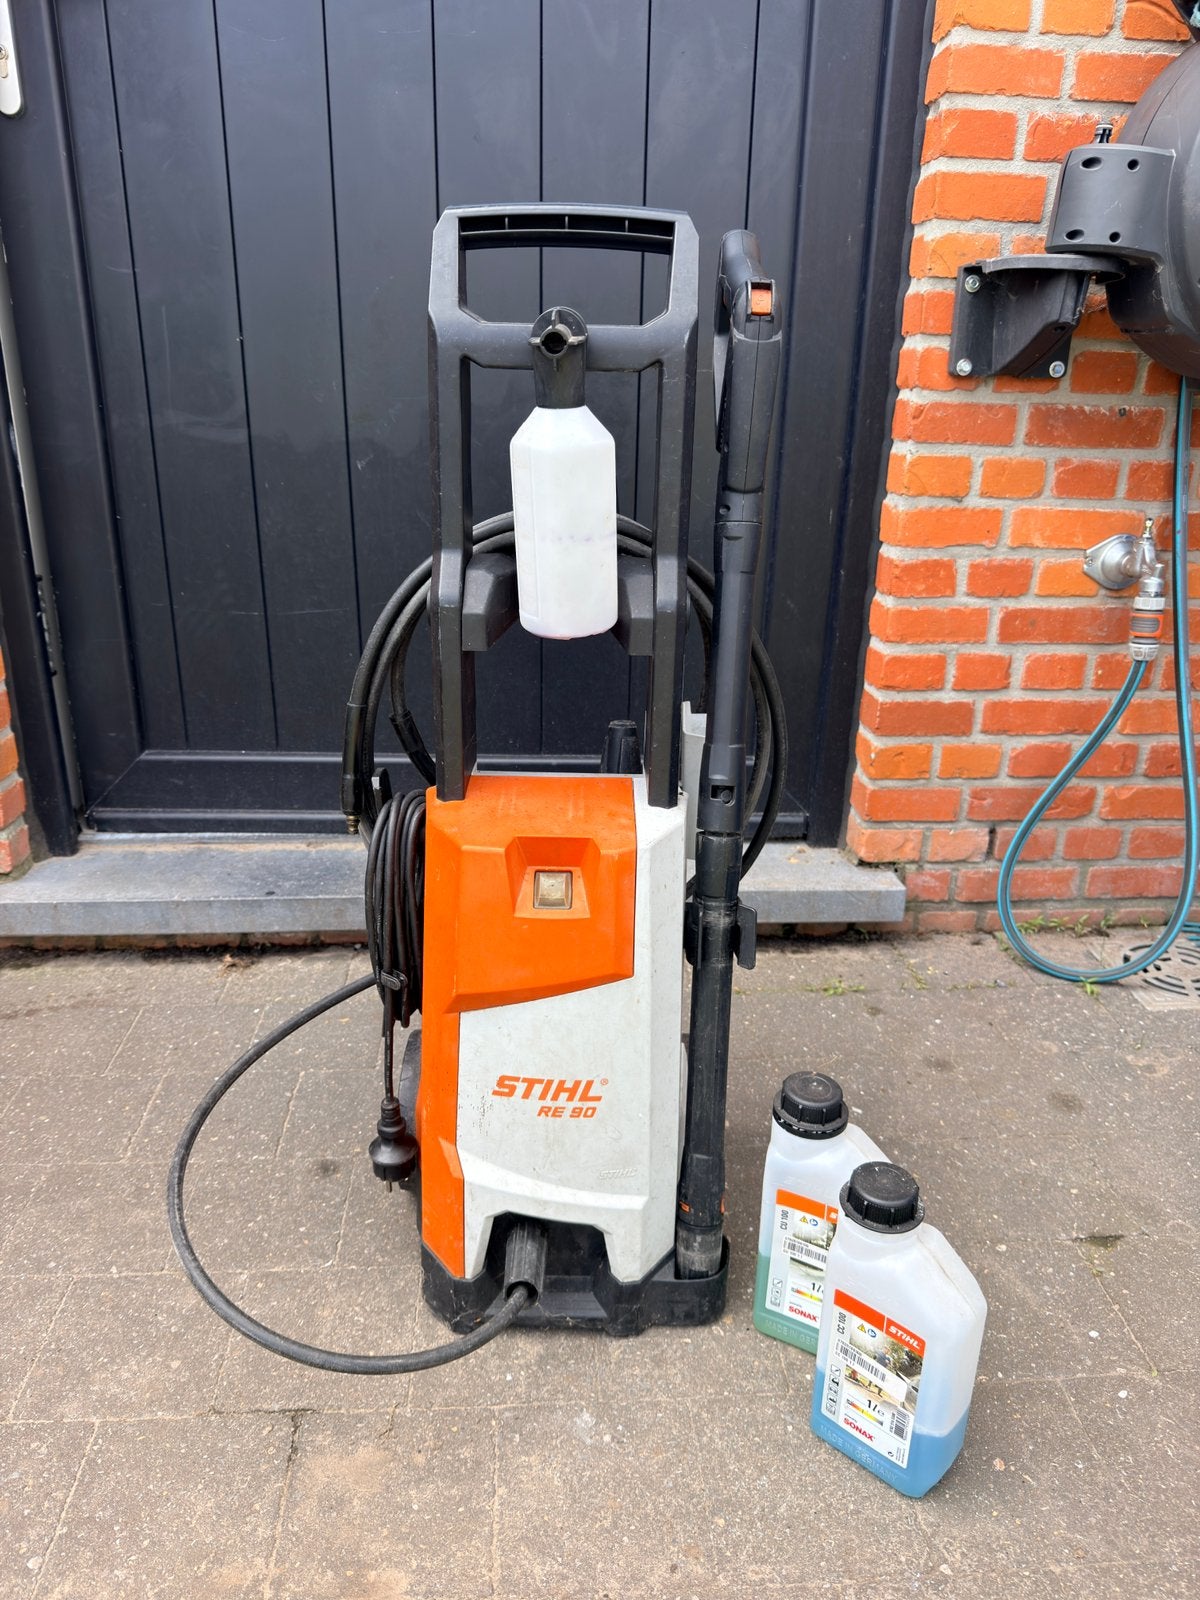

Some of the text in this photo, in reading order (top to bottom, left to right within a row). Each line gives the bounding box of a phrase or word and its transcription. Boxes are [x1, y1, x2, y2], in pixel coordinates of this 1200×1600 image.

[492, 1075, 602, 1102] STIHL
[537, 1106, 597, 1118] RE 90
[780, 1209, 789, 1231] CU 100
[788, 1305, 818, 1323] SONAX
[837, 1311, 847, 1335] CC 100
[888, 1325, 920, 1350] STIHL
[843, 1417, 874, 1442] SONAX
